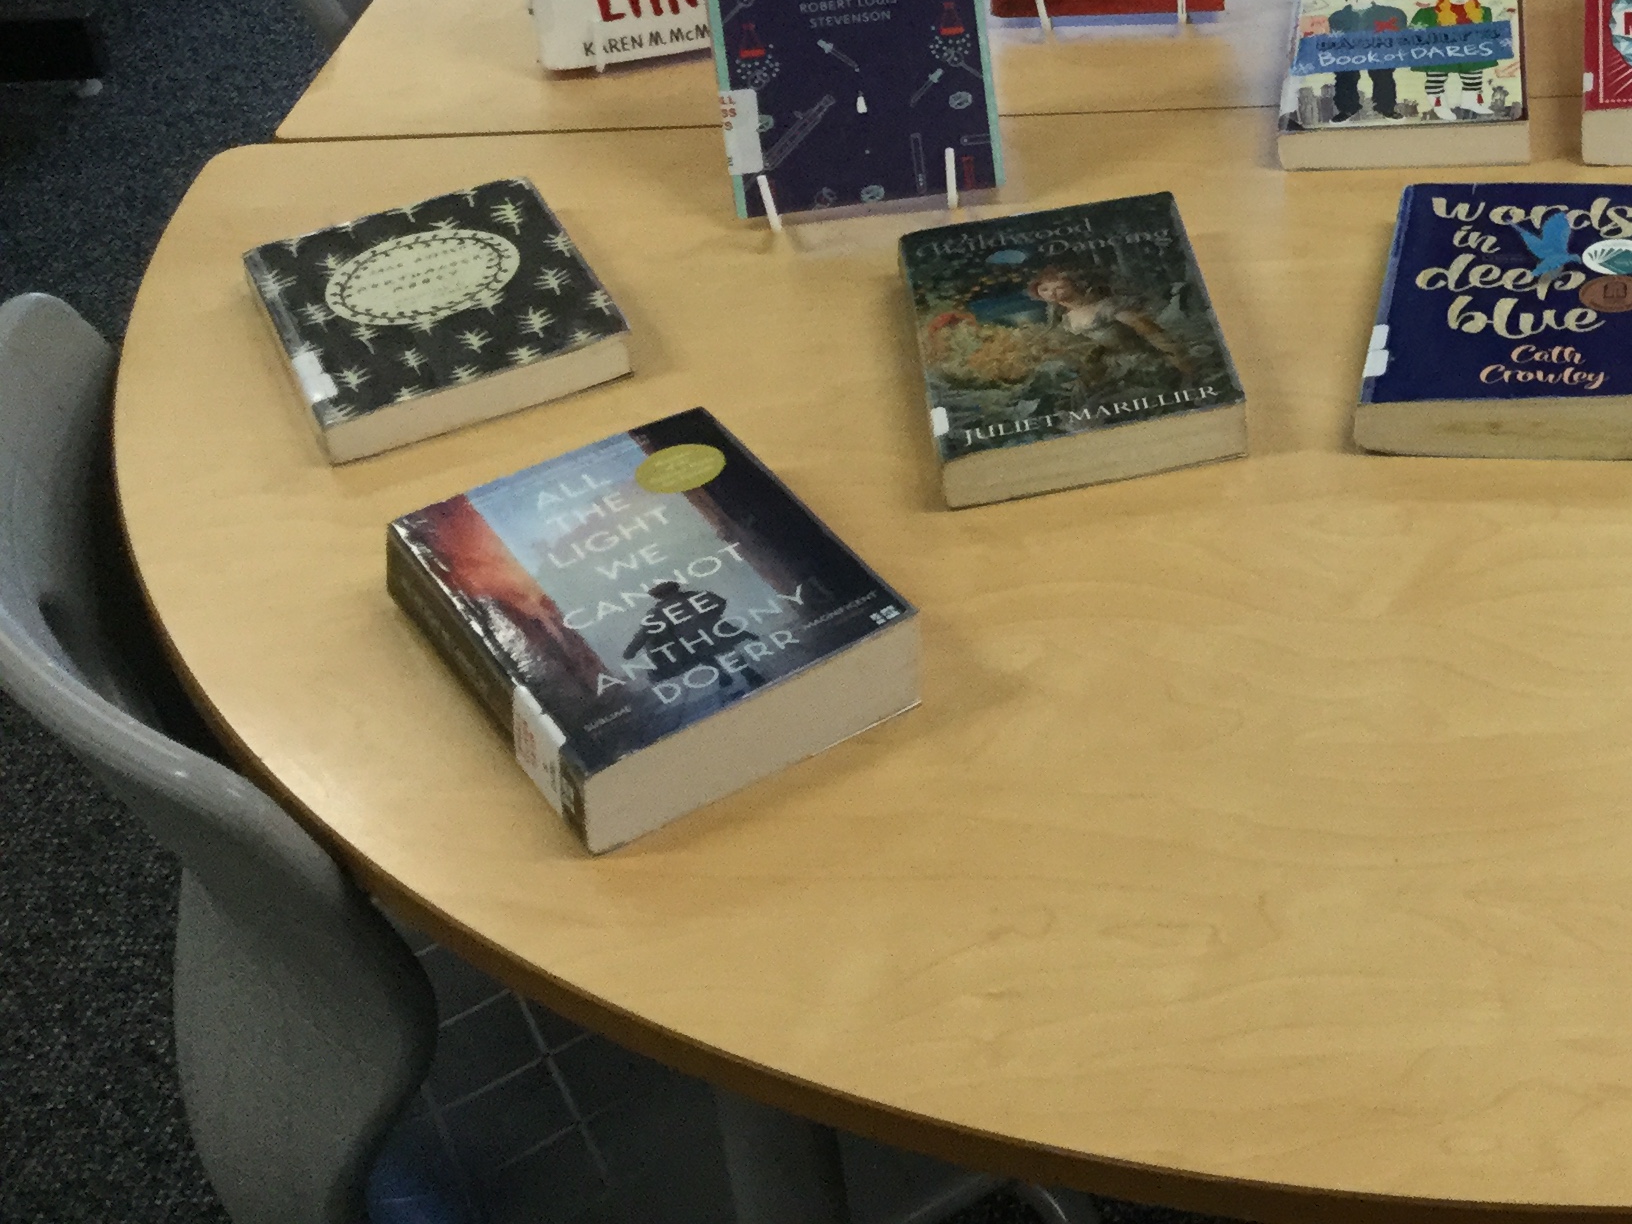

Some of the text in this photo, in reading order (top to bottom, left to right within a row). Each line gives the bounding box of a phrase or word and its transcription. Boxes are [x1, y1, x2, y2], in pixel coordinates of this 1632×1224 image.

[669, 23, 711, 44] McM
[808, 10, 892, 29] STEVENSON
[1384, 42, 1494, 62] of DARES
[1452, 225, 1501, 254] in
[1415, 253, 1587, 300] deep
[1446, 294, 1607, 340] blue
[1511, 343, 1586, 365] Cath
[1479, 363, 1610, 390] Crowley
[965, 385, 1219, 446] JULIET MARILLIER
[537, 471, 611, 512] ALL
[545, 490, 633, 532] THE
[547, 505, 672, 570] LIGHT
[594, 543, 668, 582] WE
[562, 541, 746, 632] CANNOT
[641, 589, 721, 635] SEE
[595, 583, 808, 697] ANTHONY
[652, 629, 802, 706] DOERR
